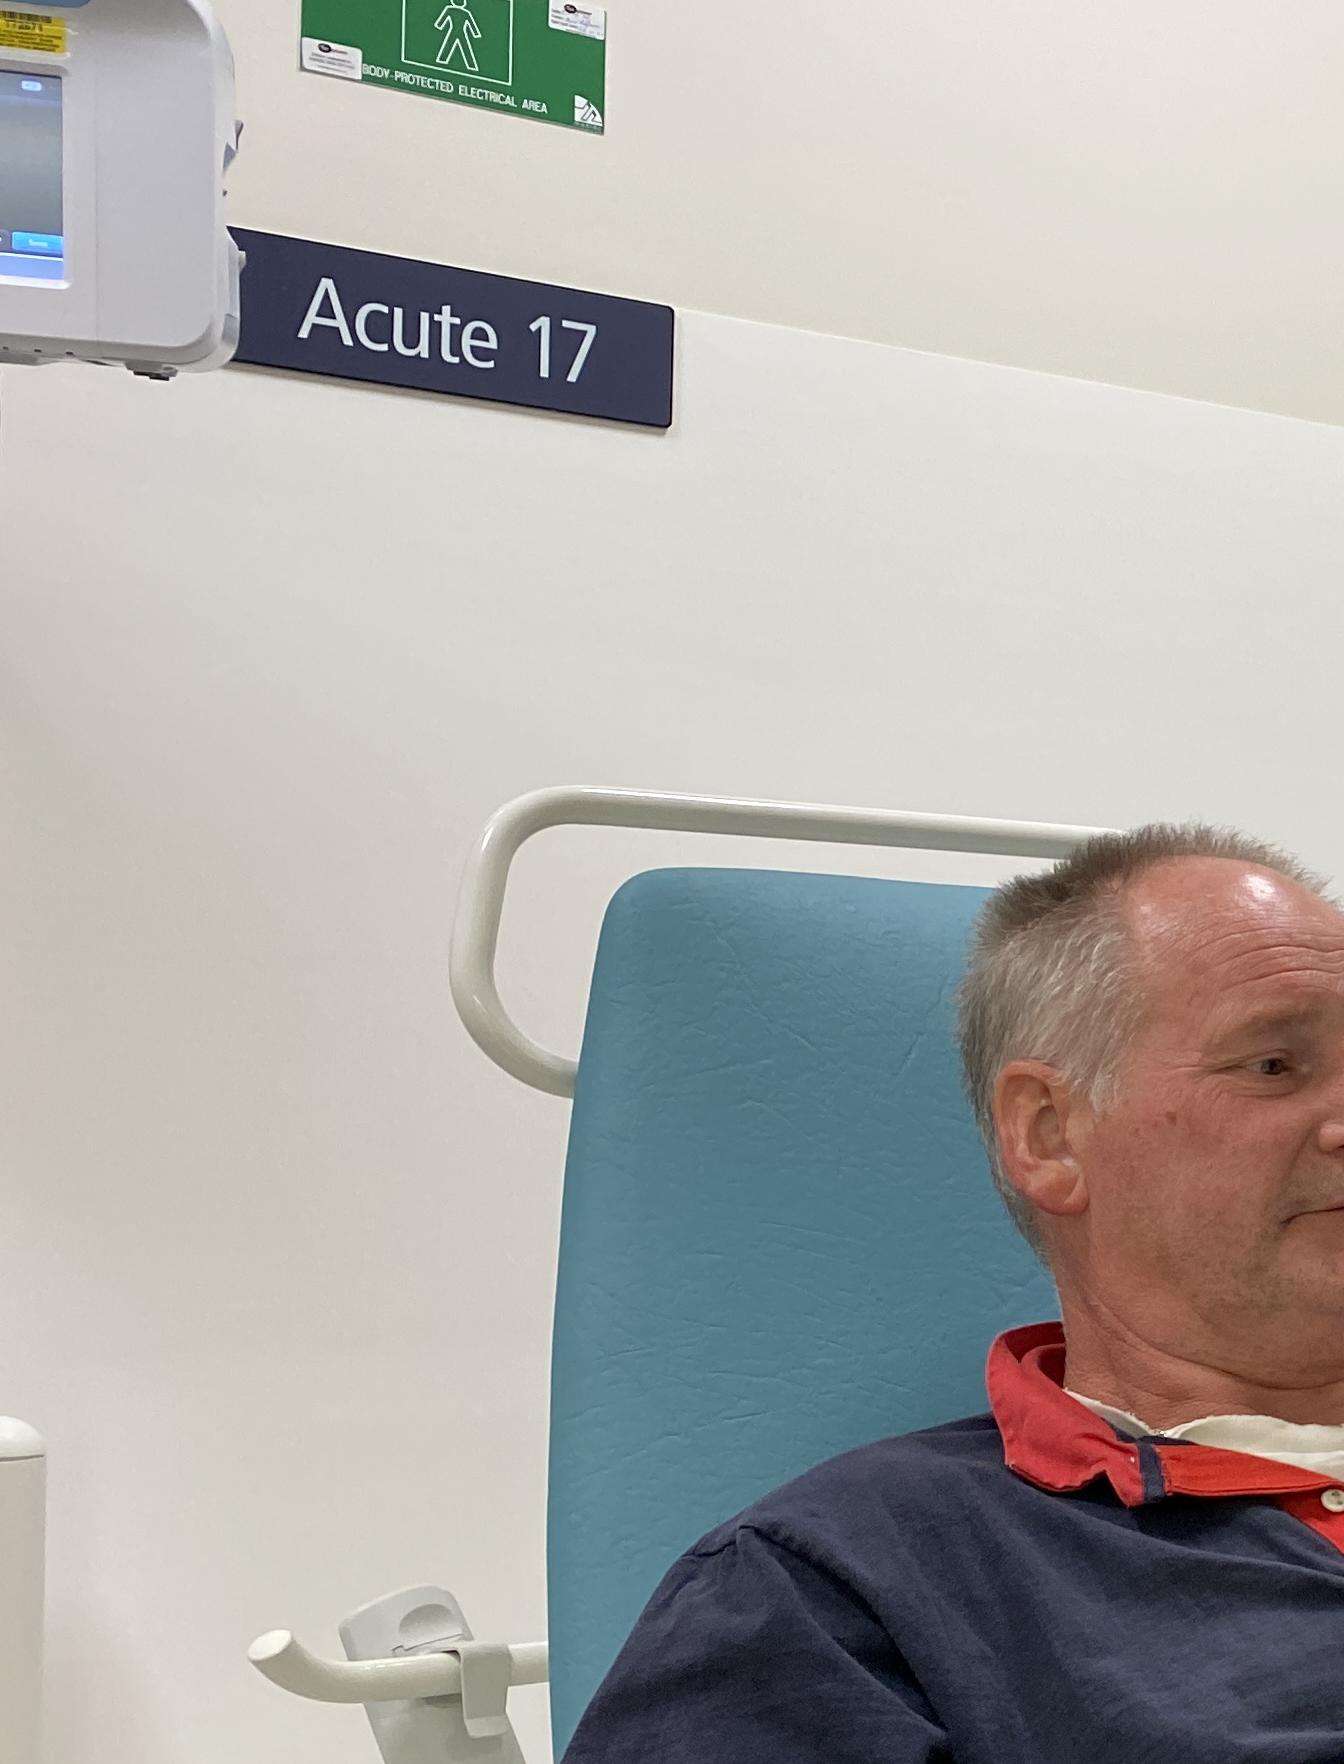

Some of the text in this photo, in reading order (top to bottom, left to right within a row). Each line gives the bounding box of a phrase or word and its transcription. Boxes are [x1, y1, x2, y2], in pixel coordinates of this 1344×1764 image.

[458, 84, 517, 107] ELECTRICAL
[521, 99, 548, 114] AREA
[297, 277, 598, 383] Acute 17
